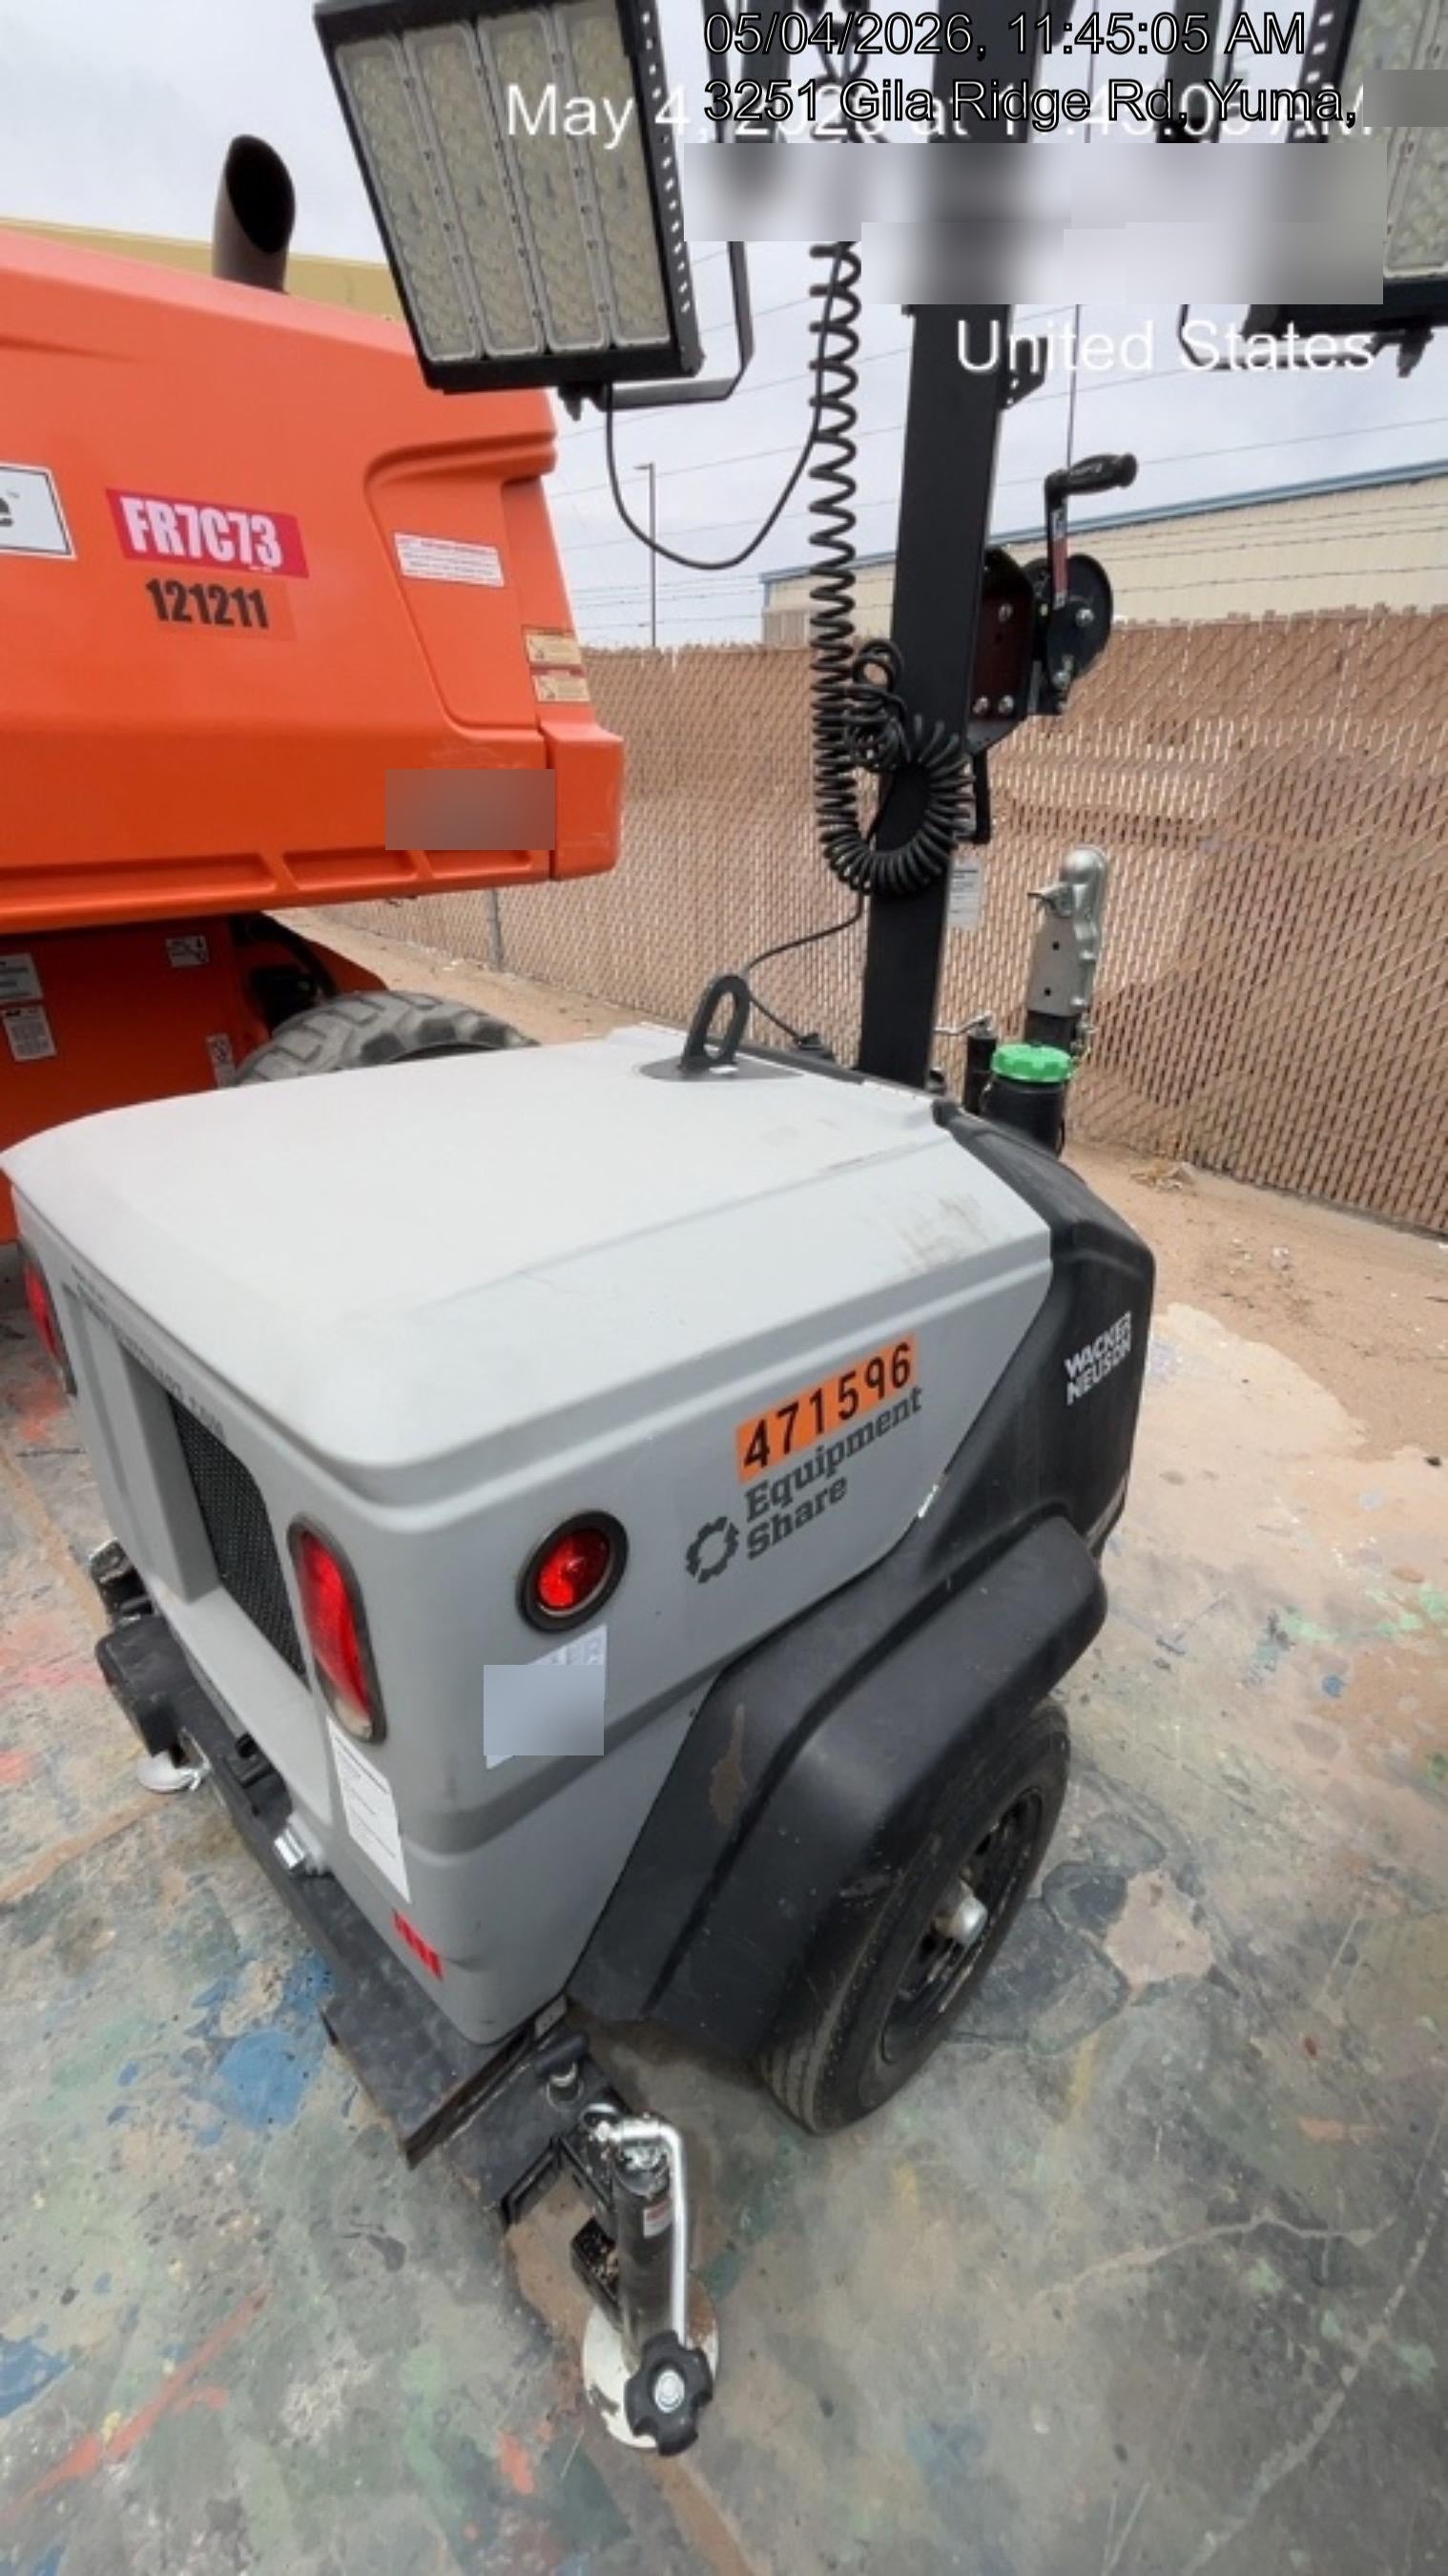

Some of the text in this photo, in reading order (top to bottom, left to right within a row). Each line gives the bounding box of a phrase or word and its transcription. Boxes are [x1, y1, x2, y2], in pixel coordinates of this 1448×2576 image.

[120, 495, 284, 570] FR7C73
[145, 577, 269, 630] 121211
[1064, 1310, 1132, 1379] WACKER
[1066, 1338, 1131, 1406] NEUSON
[743, 1341, 911, 1469] 471596
[744, 1386, 922, 1524] Equipment
[747, 1476, 848, 1561] Share
